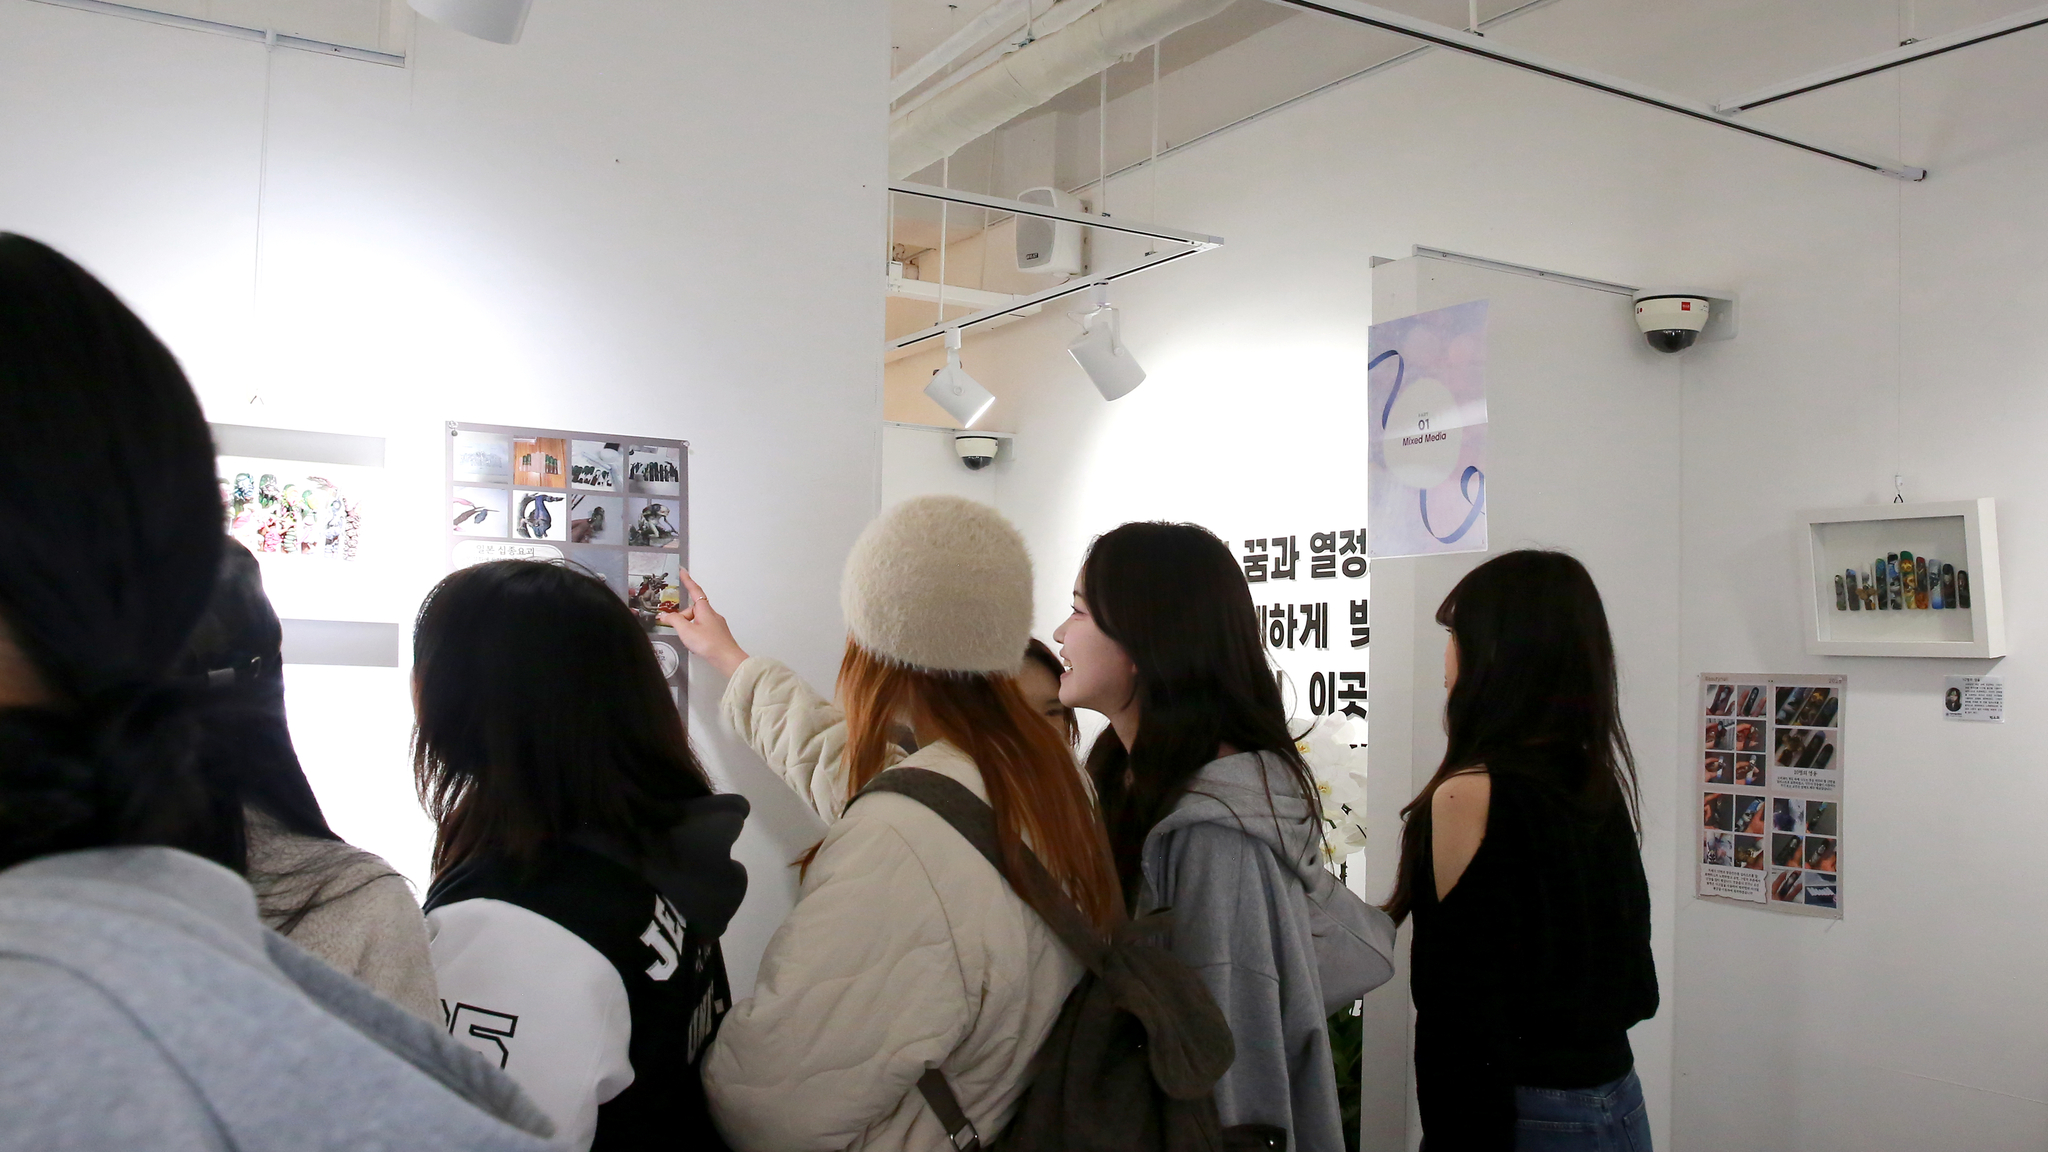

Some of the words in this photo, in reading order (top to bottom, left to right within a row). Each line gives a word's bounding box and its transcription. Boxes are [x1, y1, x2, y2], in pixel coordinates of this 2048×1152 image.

[1418, 418, 1429, 431] 01
[1402, 434, 1423, 446] Mixed
[1425, 431, 1447, 443] Media
[476, 544, 495, 555] 일본
[1243, 535, 1299, 582] 꿈과
[1310, 528, 1367, 578] 열정
[1309, 671, 1367, 718] 이곳
